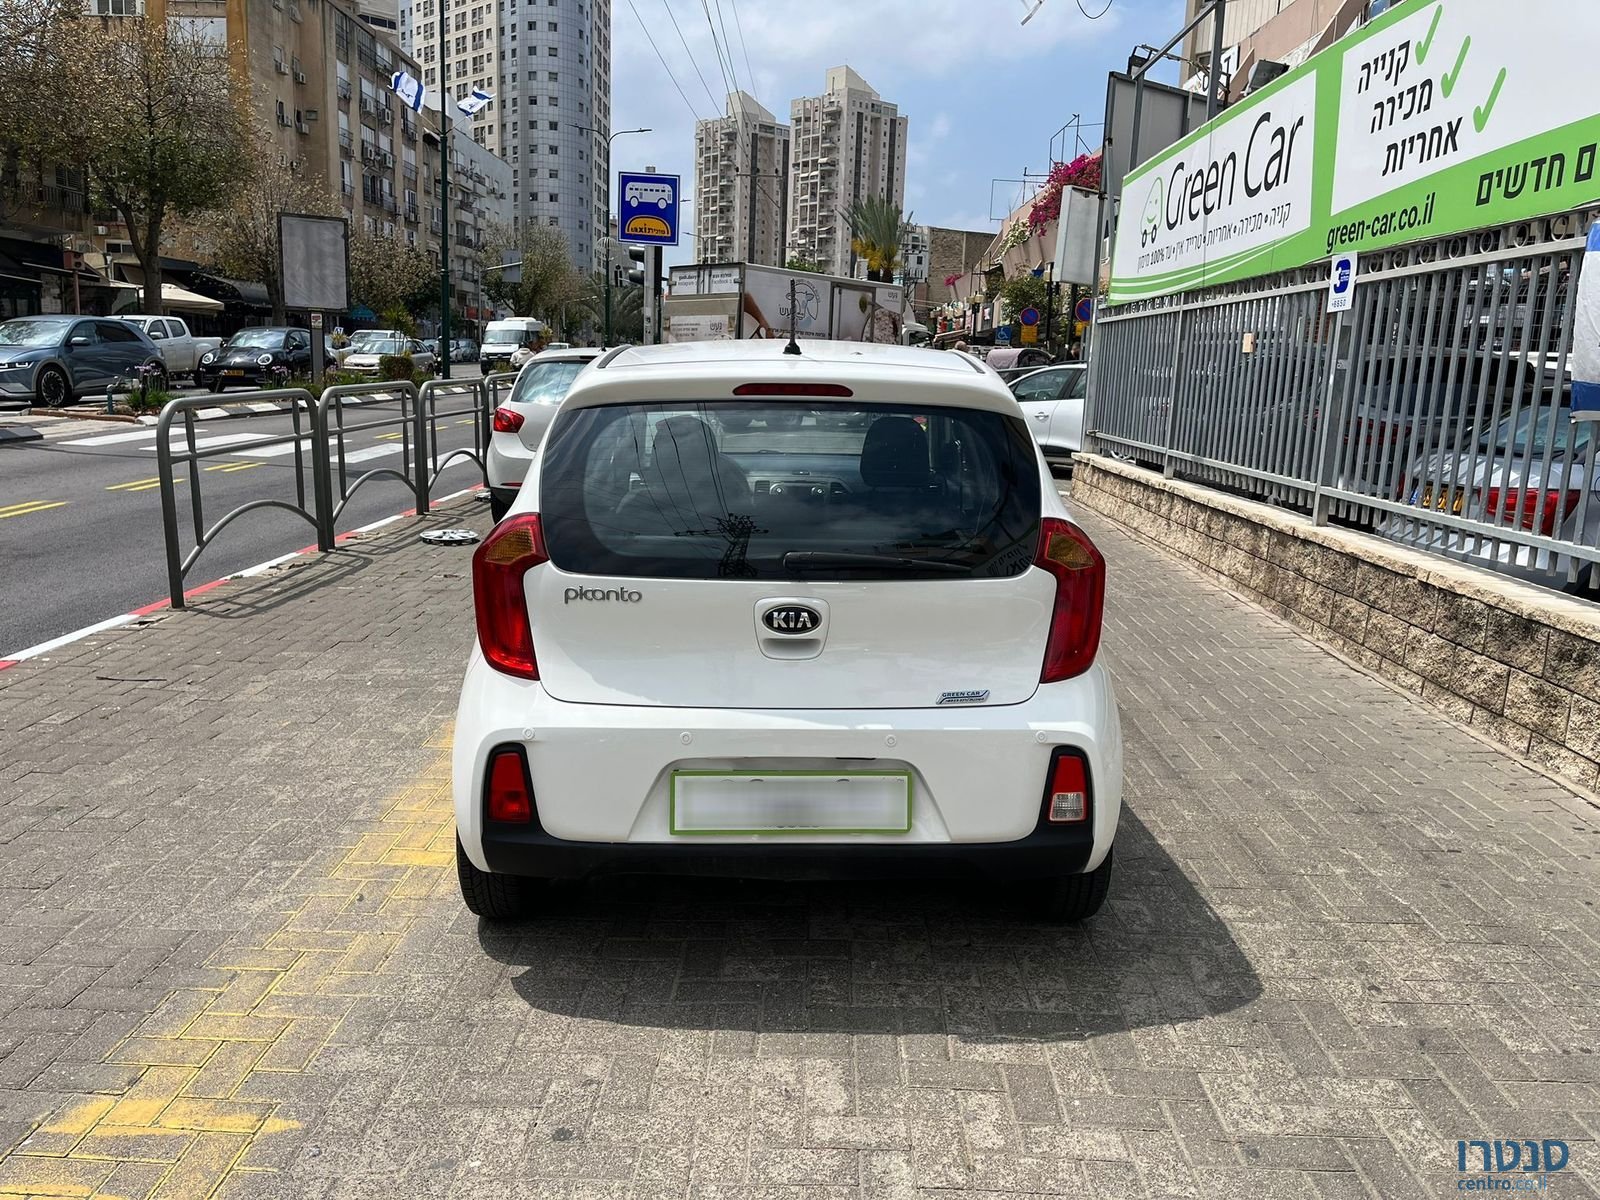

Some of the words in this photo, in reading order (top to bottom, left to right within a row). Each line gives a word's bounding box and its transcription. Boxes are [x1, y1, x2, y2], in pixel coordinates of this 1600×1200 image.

[1357, 40, 1411, 94] קנייה
[1370, 78, 1433, 134] מכירה
[1165, 152, 1237, 231] Green
[1243, 112, 1304, 198] Car
[1381, 116, 1464, 177] אחריות
[1475, 152, 1566, 207] חדשים
[1206, 223, 1233, 247] אחריות
[1237, 212, 1263, 237] מכירה
[1268, 202, 1292, 229] קניה
[1326, 191, 1436, 255] green-car.co.il
[564, 586, 643, 605] picanto
[772, 611, 813, 629] KIA
